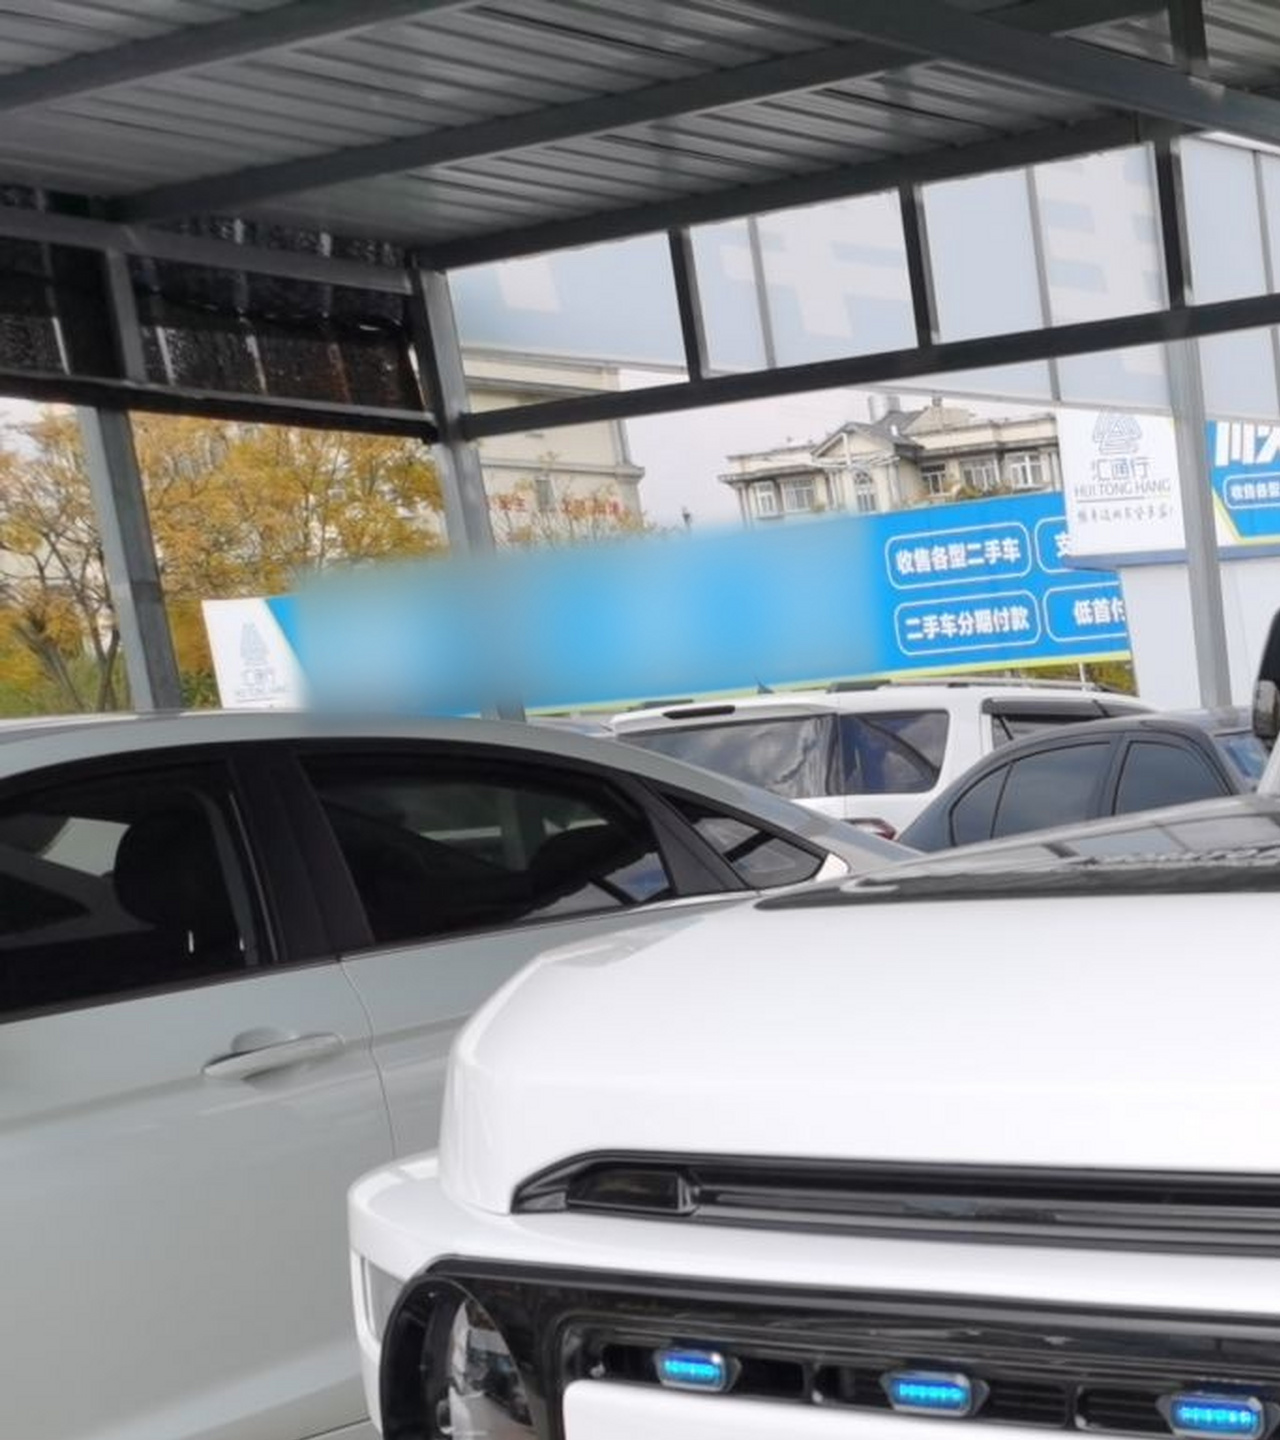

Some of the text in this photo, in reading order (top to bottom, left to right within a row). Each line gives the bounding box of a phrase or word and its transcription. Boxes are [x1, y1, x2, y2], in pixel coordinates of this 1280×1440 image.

[1090, 456, 1155, 481] 汇通行
[1097, 480, 1133, 496] TONG
[1134, 477, 1172, 493] HANG
[895, 536, 1022, 576] 收售各型二手车
[905, 605, 1031, 641] 二手车分期付款
